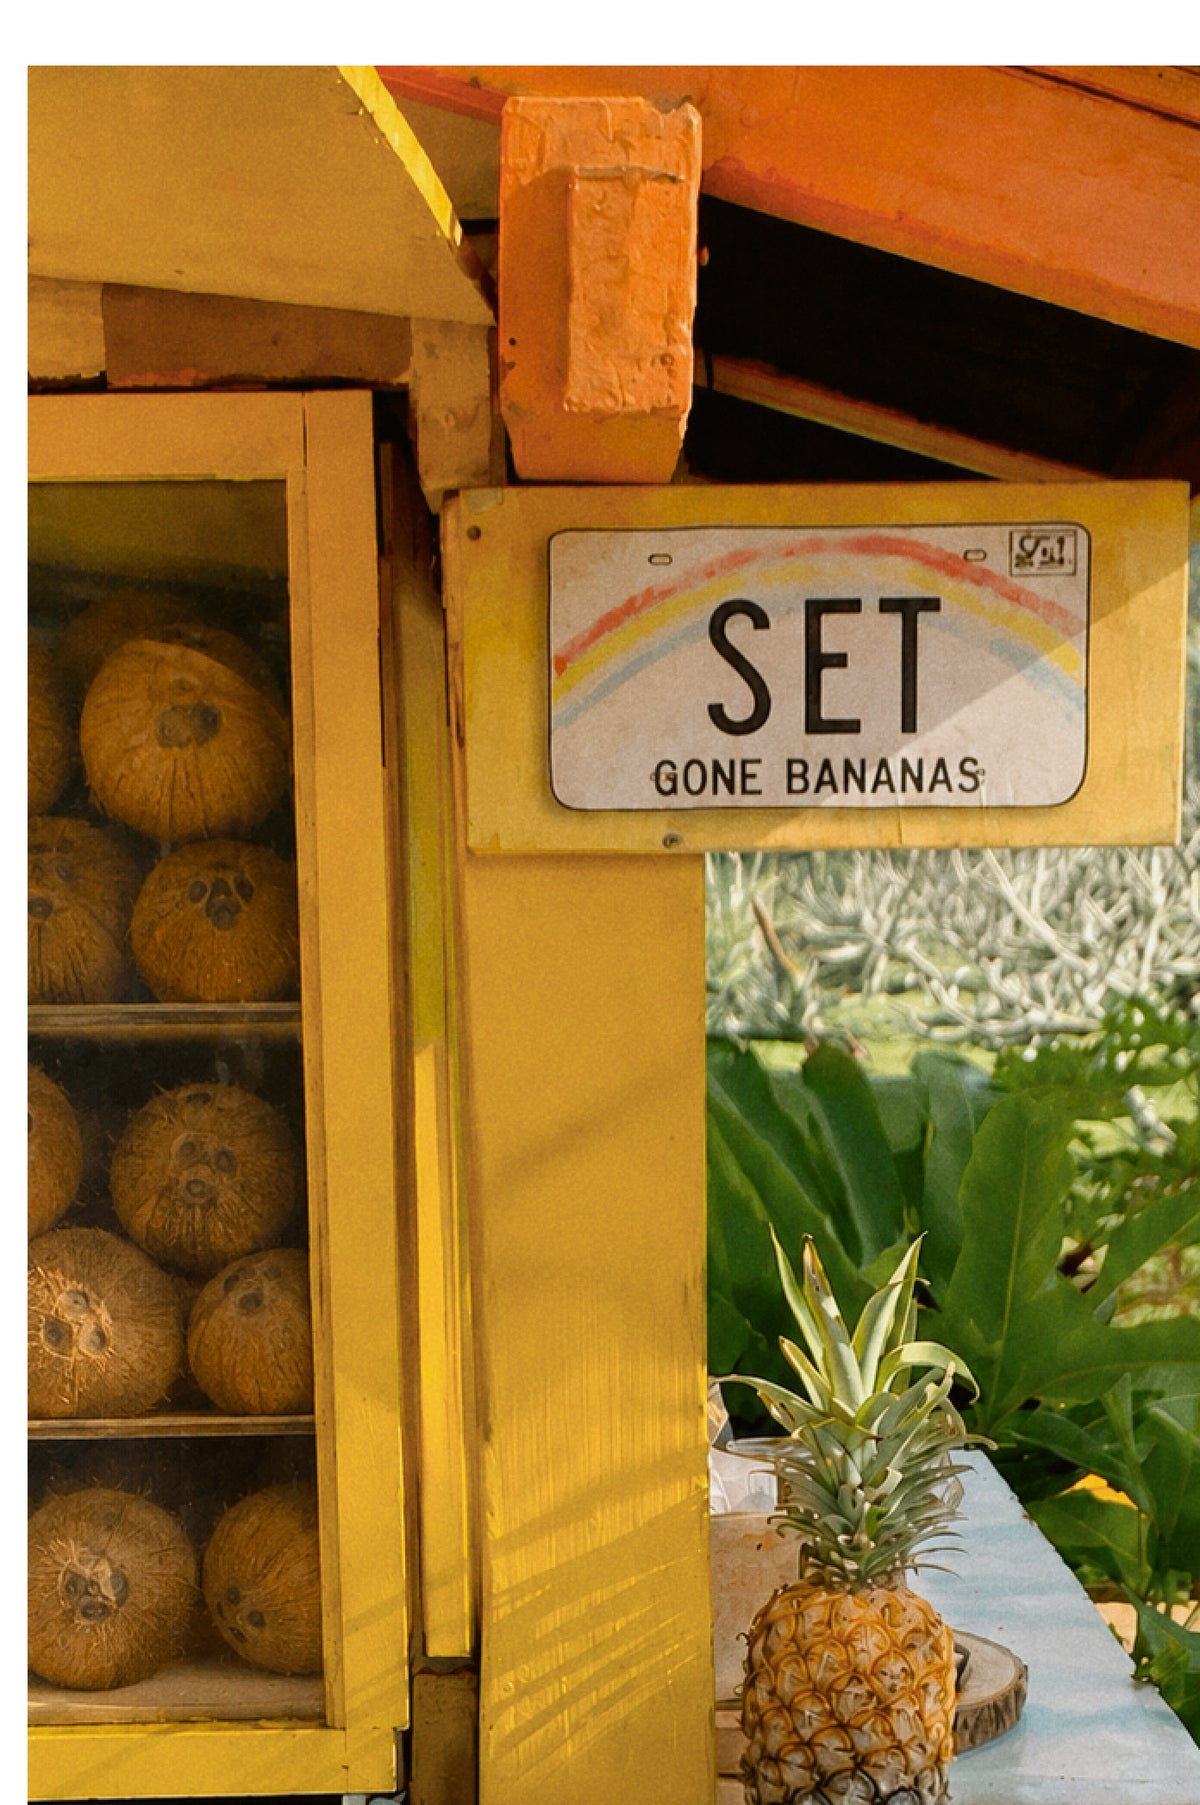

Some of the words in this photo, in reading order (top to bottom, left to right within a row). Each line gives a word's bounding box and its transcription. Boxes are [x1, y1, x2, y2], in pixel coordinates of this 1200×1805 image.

[708, 598, 941, 736] SET
[655, 758, 763, 796] GONE
[786, 757, 982, 794] BANANAS
